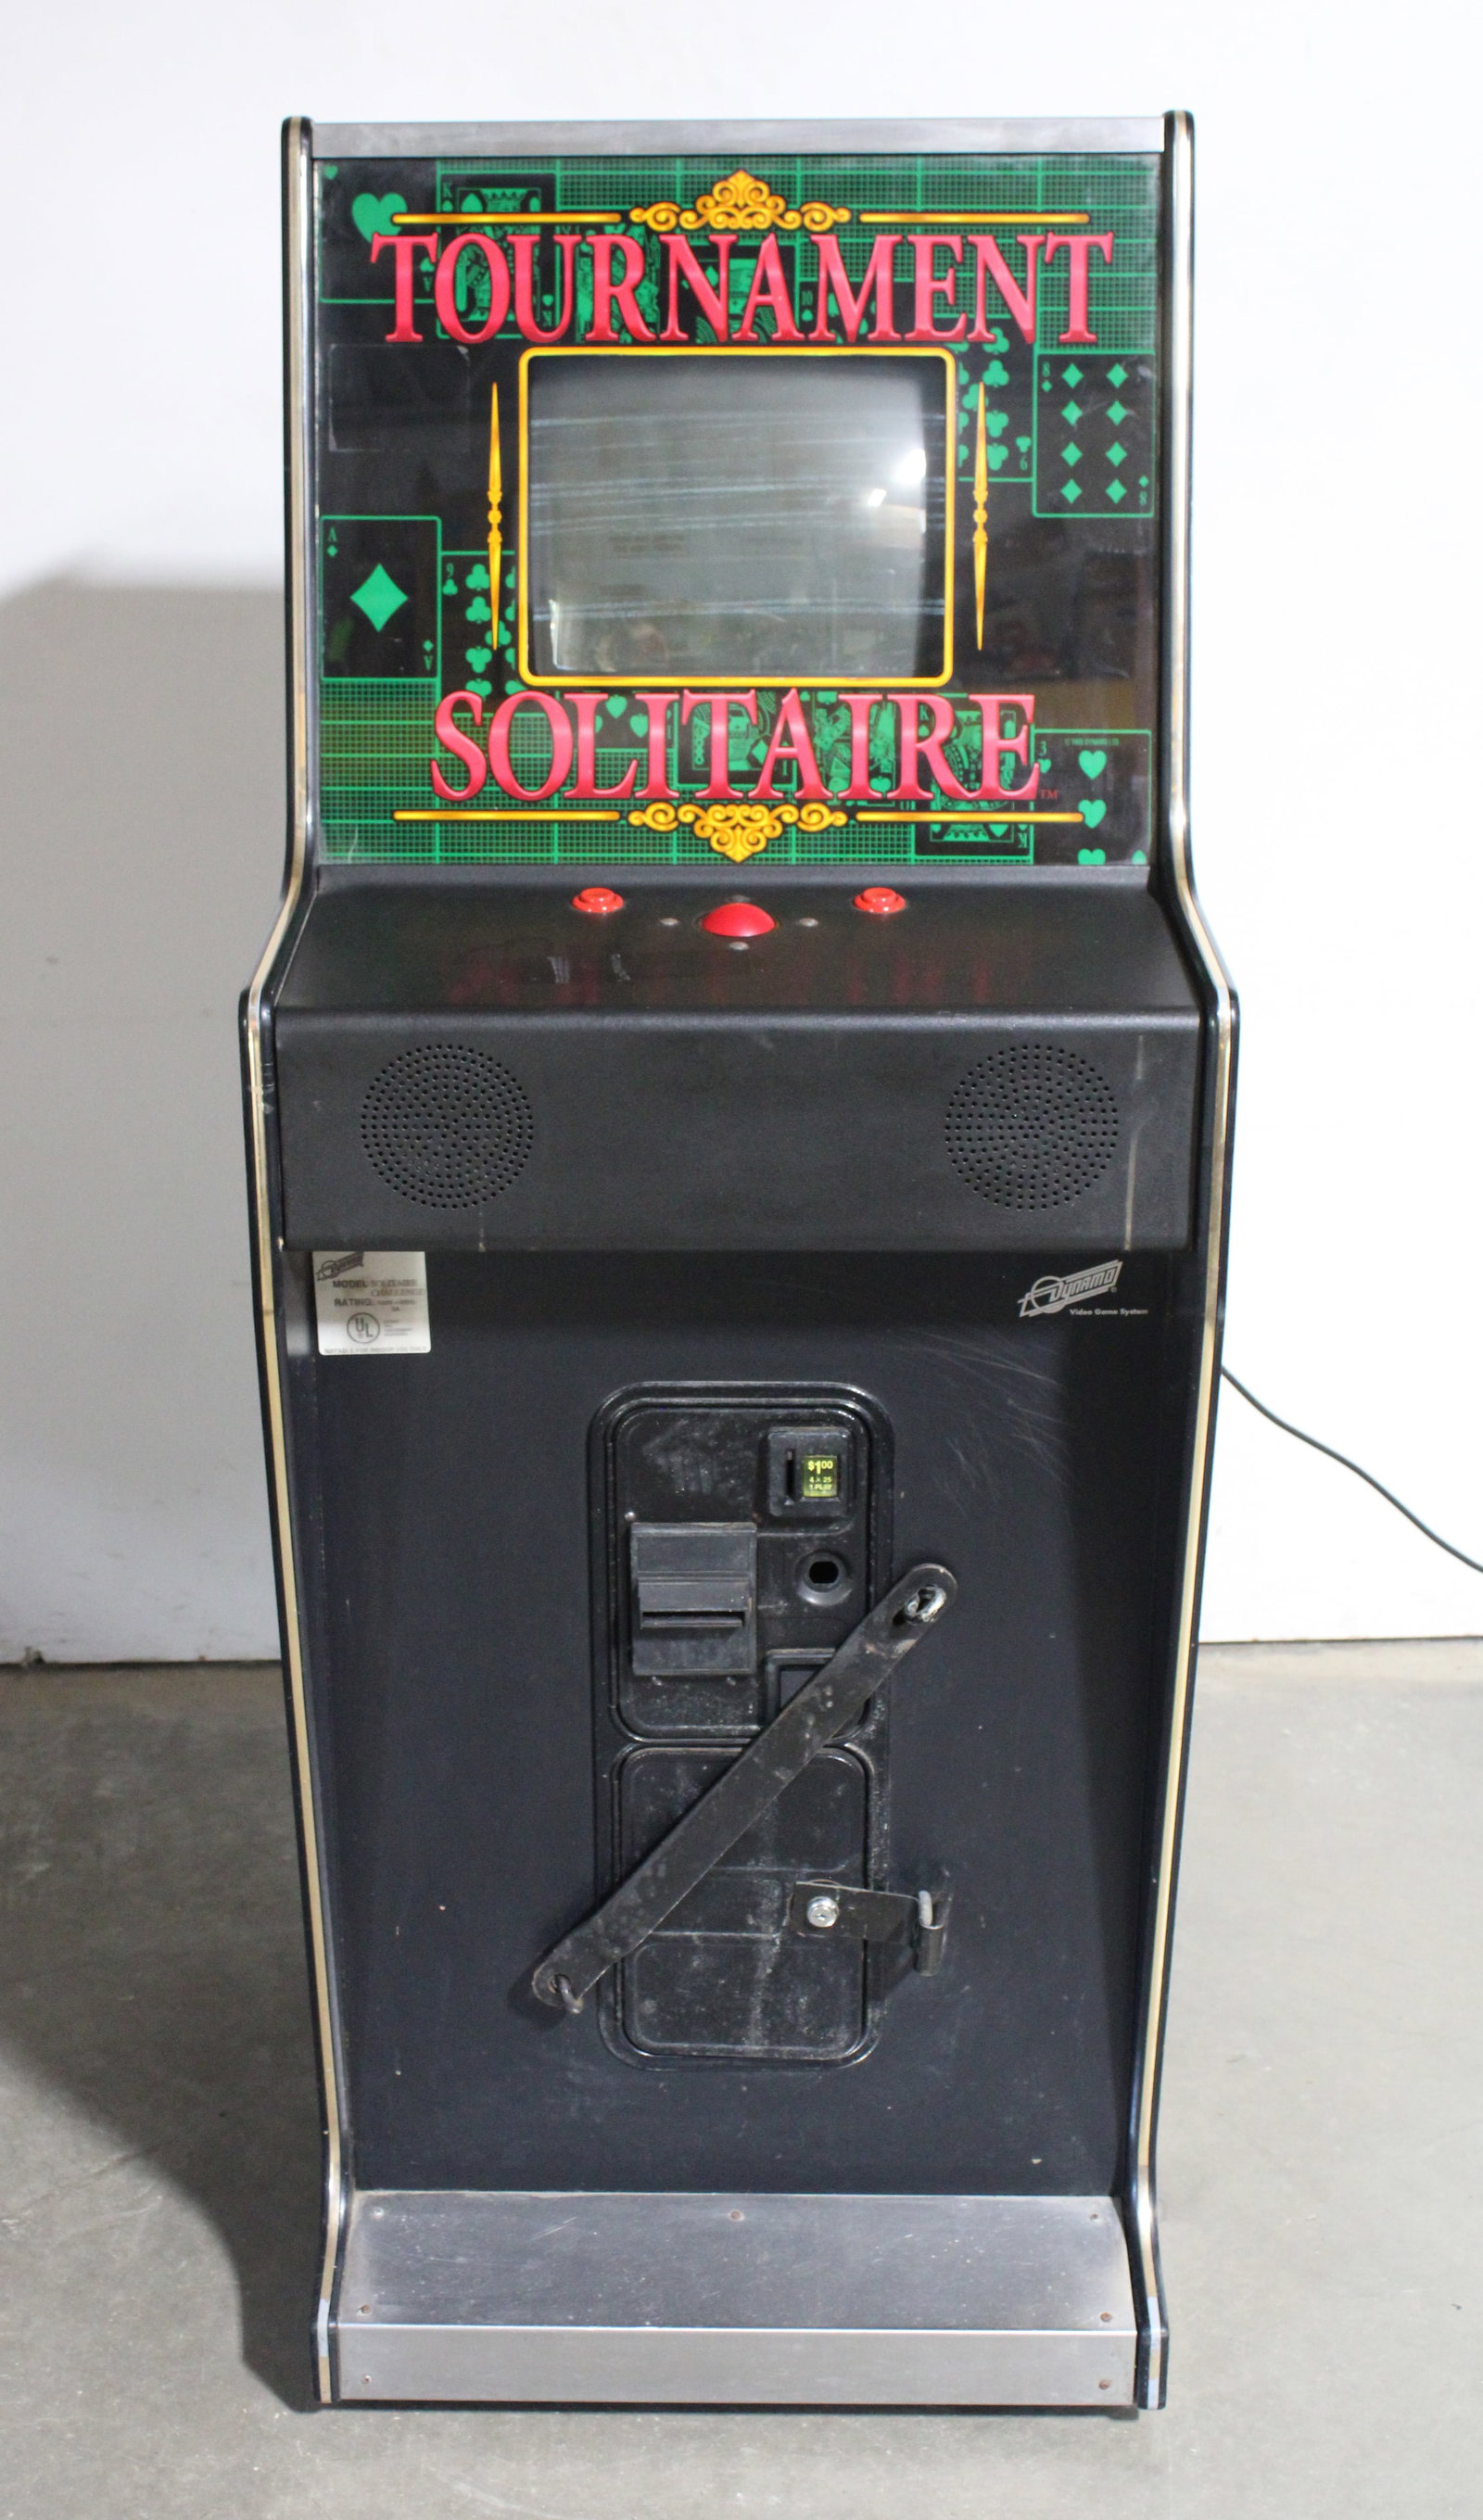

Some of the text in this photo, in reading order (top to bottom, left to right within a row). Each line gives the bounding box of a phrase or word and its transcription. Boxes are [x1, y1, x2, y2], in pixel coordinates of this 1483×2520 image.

[370, 231, 1115, 343] TOURNAMENT
[431, 687, 1040, 801] SOLITAIRE
[1120, 1308, 1148, 1317] System
